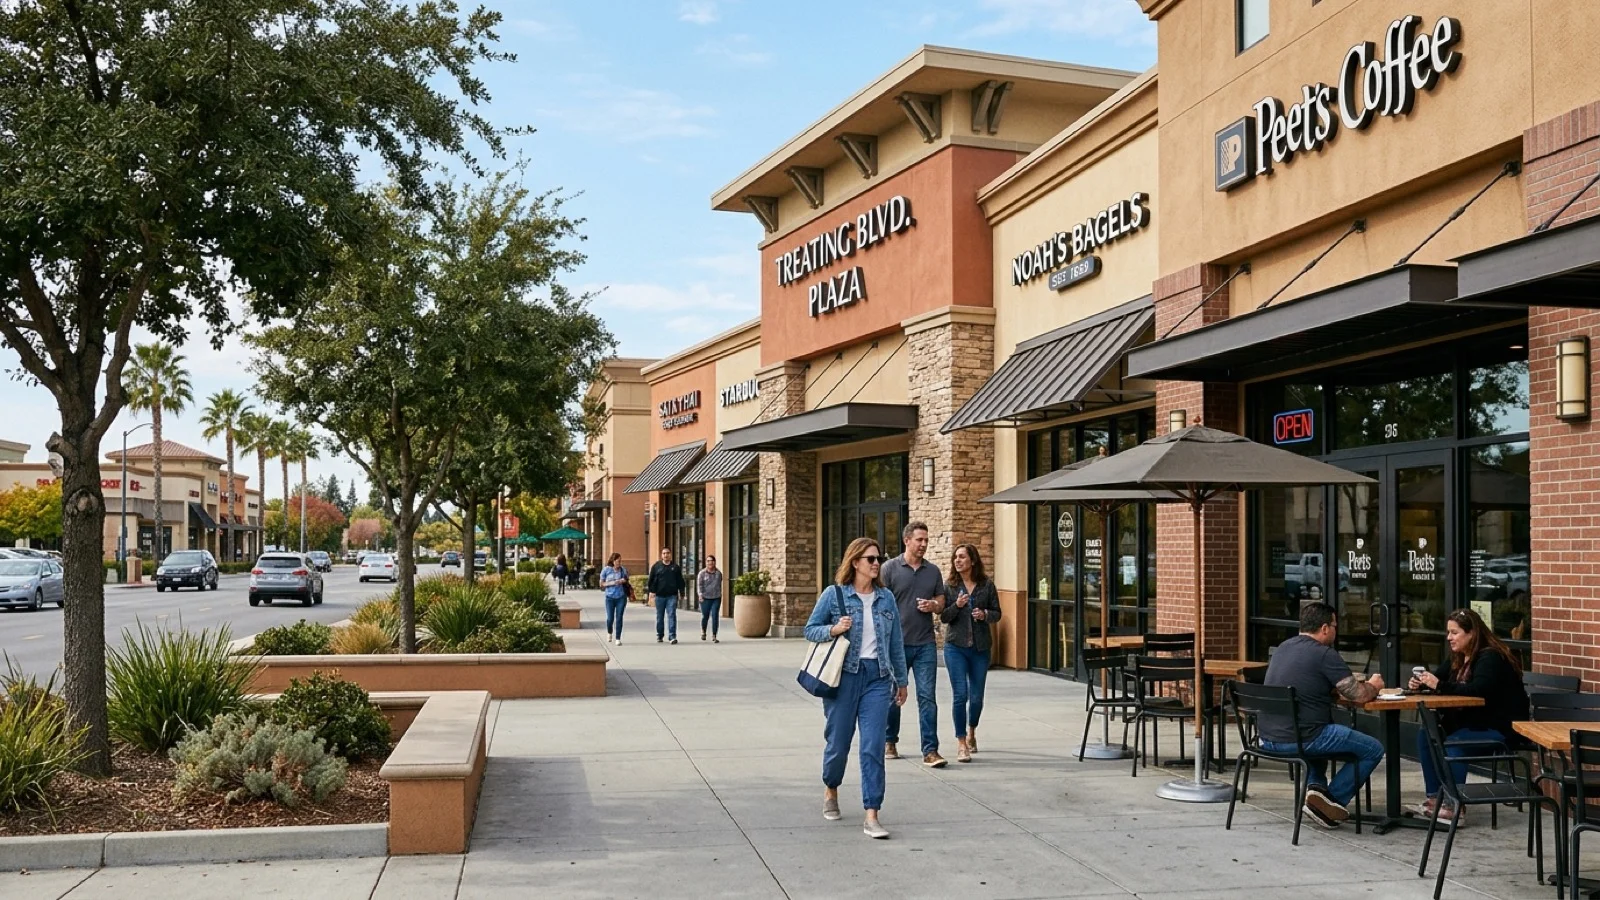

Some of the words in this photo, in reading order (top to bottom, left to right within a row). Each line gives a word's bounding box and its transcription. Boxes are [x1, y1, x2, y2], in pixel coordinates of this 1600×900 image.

[1252, 82, 1335, 176] Peet's
[1338, 14, 1460, 130] Coffee
[775, 221, 853, 288] TREATING
[857, 195, 913, 250] BLVD.
[1012, 231, 1068, 286] NOAH'S
[1072, 191, 1147, 257] BAGELS
[808, 267, 864, 318] PLAZA
[1276, 413, 1312, 441] OPEN
